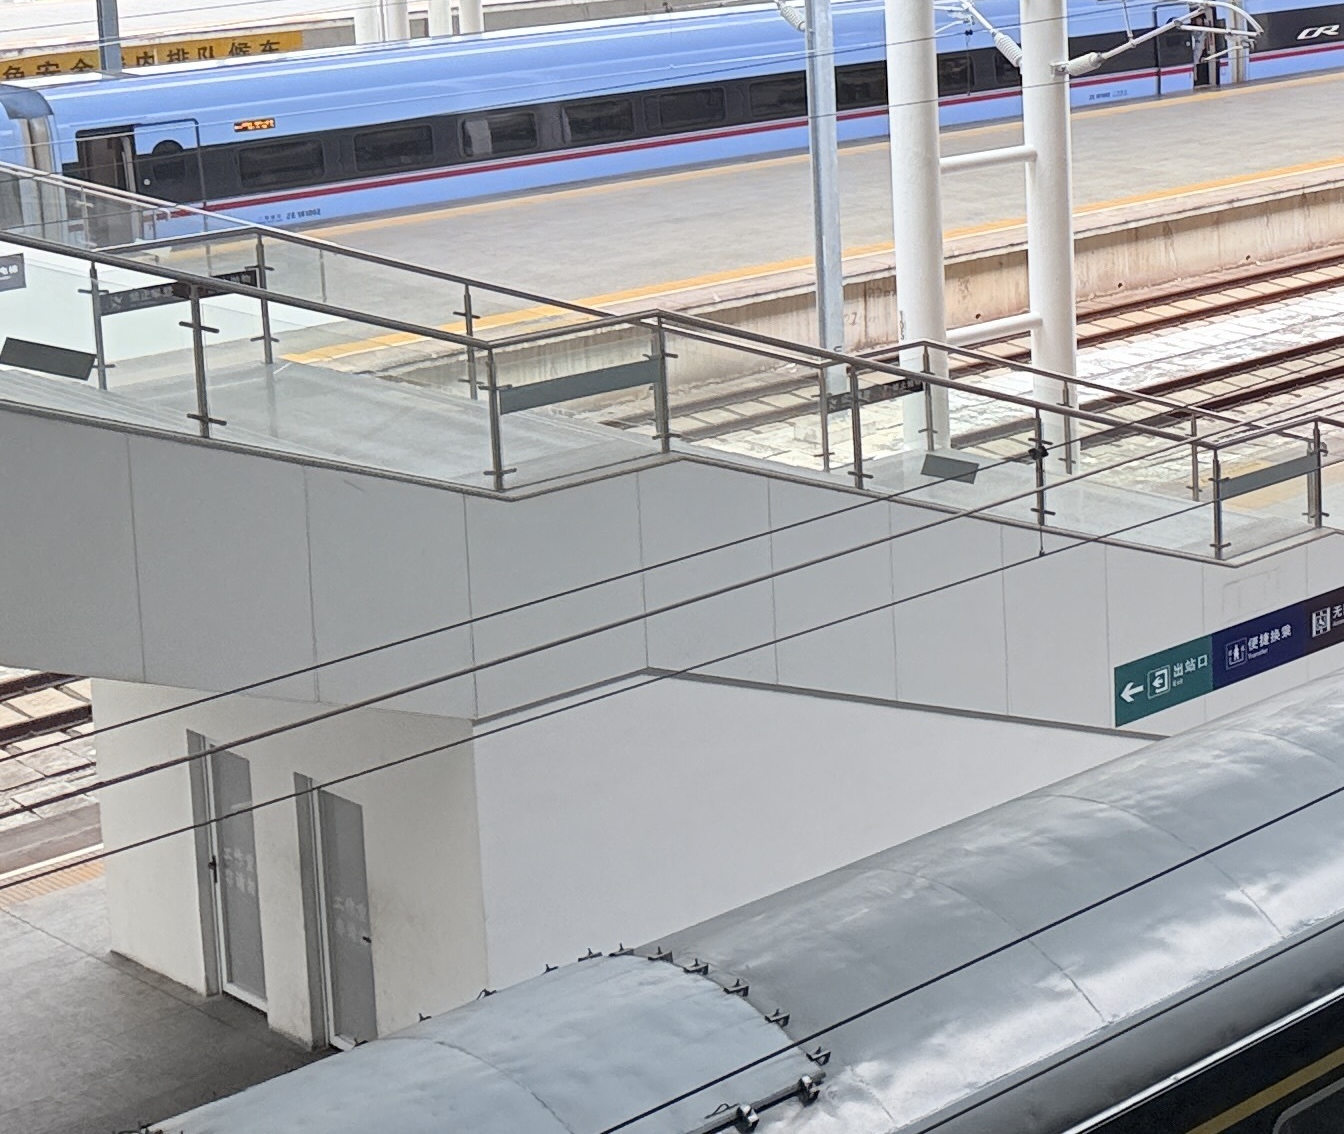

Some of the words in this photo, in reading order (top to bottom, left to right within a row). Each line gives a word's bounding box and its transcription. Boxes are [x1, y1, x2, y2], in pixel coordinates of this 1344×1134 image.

[1296, 24, 1340, 40] CR
[3, 39, 281, 79] 色安全内排队候车
[1248, 624, 1292, 651] 便捷换乘
[1173, 654, 1208, 677] 出站口
